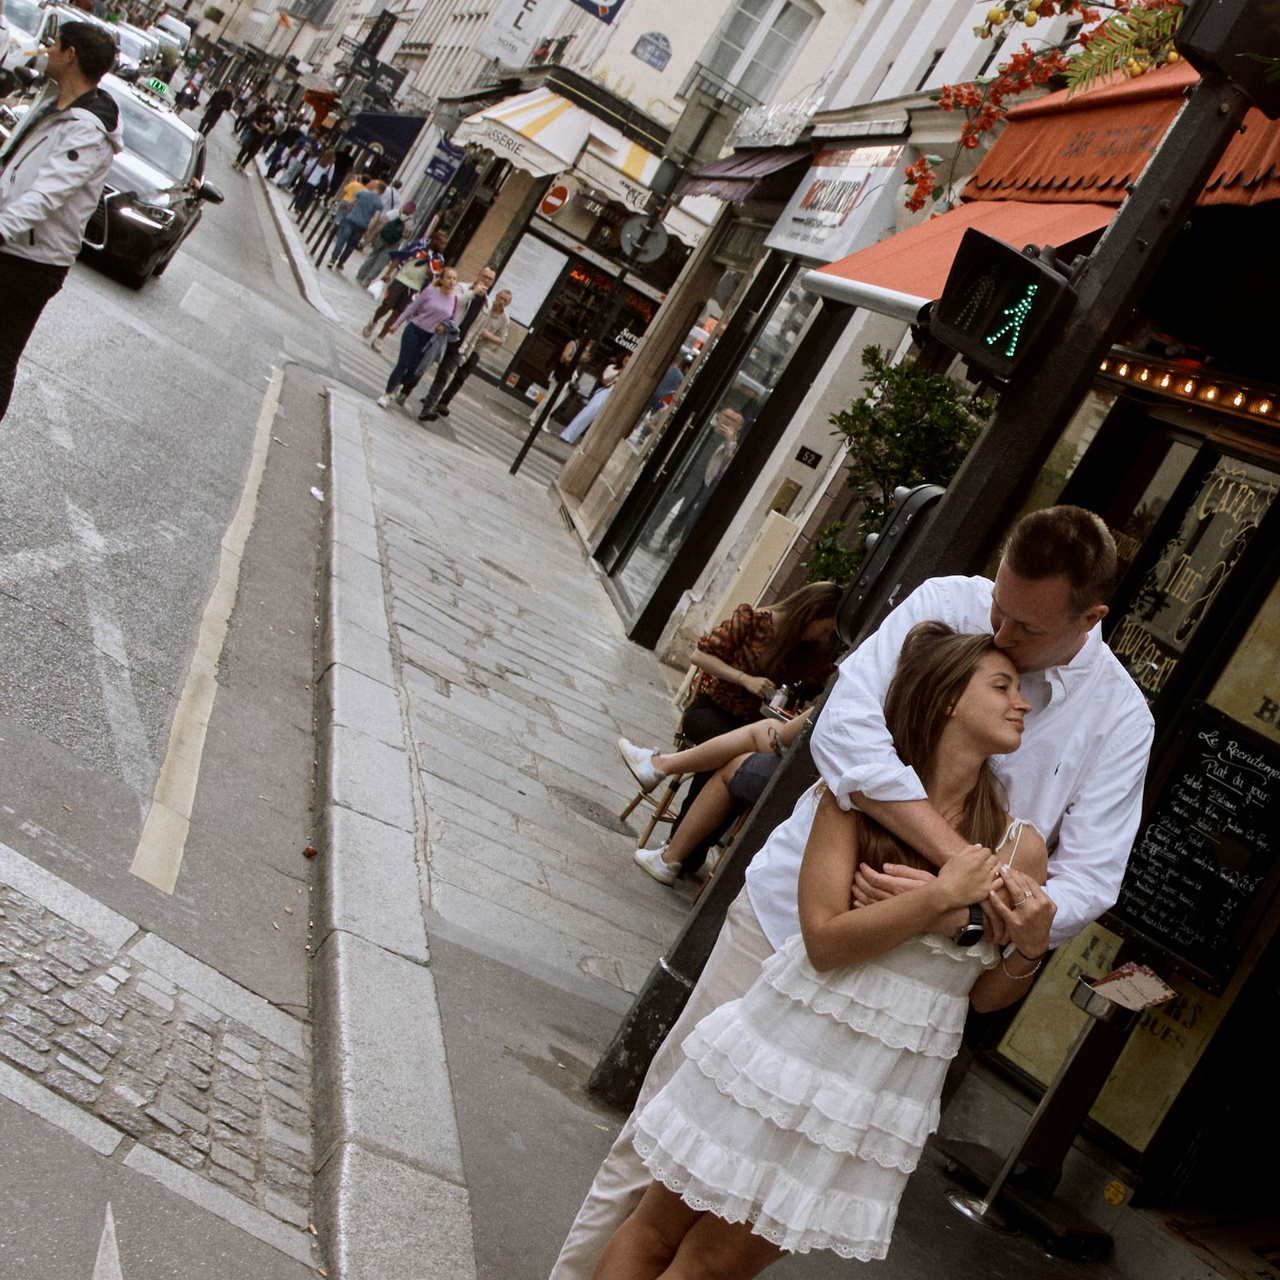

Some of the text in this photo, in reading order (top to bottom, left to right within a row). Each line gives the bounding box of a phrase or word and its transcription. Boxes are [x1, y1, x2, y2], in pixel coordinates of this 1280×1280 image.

[151, 79, 167, 94] TAXI
[801, 450, 817, 466] 52
[1197, 730, 1220, 749] Le
[1201, 759, 1229, 780] Plat
[1232, 771, 1245, 789] du
